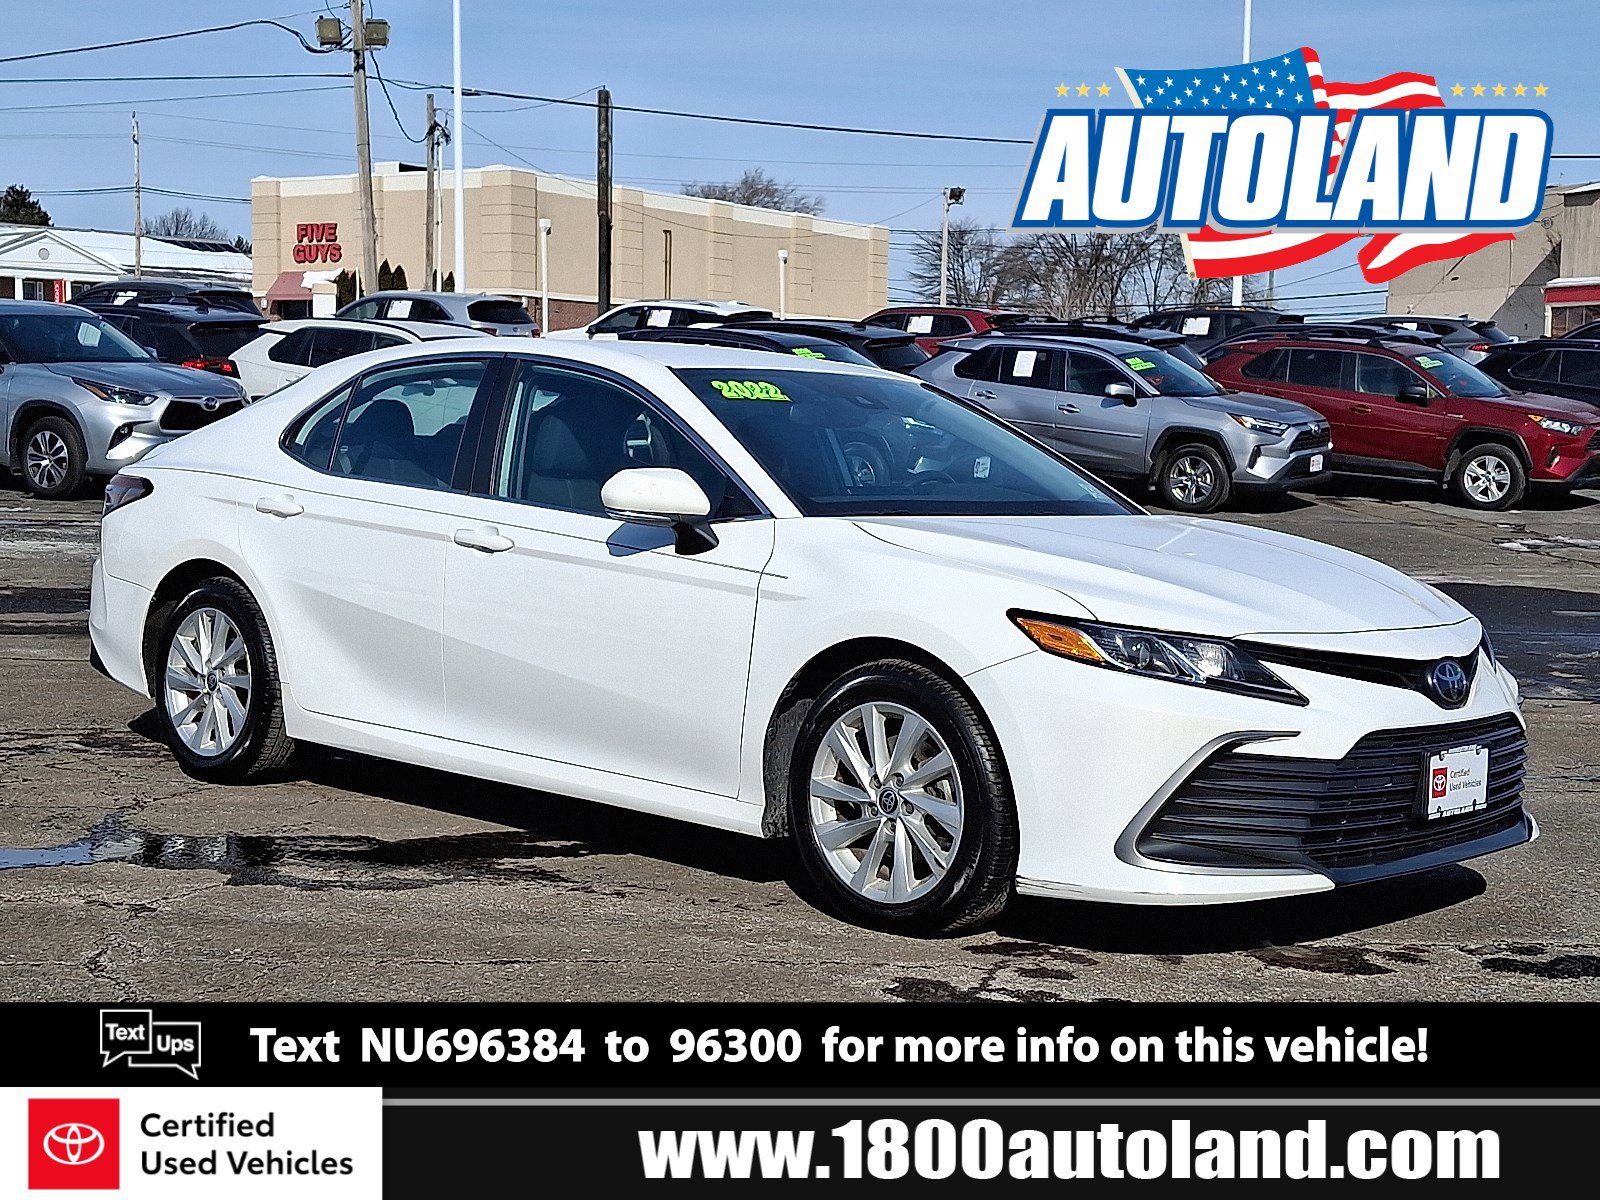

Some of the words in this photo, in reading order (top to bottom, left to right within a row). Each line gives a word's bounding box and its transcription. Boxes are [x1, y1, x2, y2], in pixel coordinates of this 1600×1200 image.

[296, 223, 338, 243] FIVE
[293, 244, 342, 264] GUYS
[711, 380, 790, 401] 2022
[1449, 768, 1471, 779] Certified
[1449, 781, 1461, 792] Used
[1462, 779, 1482, 789] Vehicles
